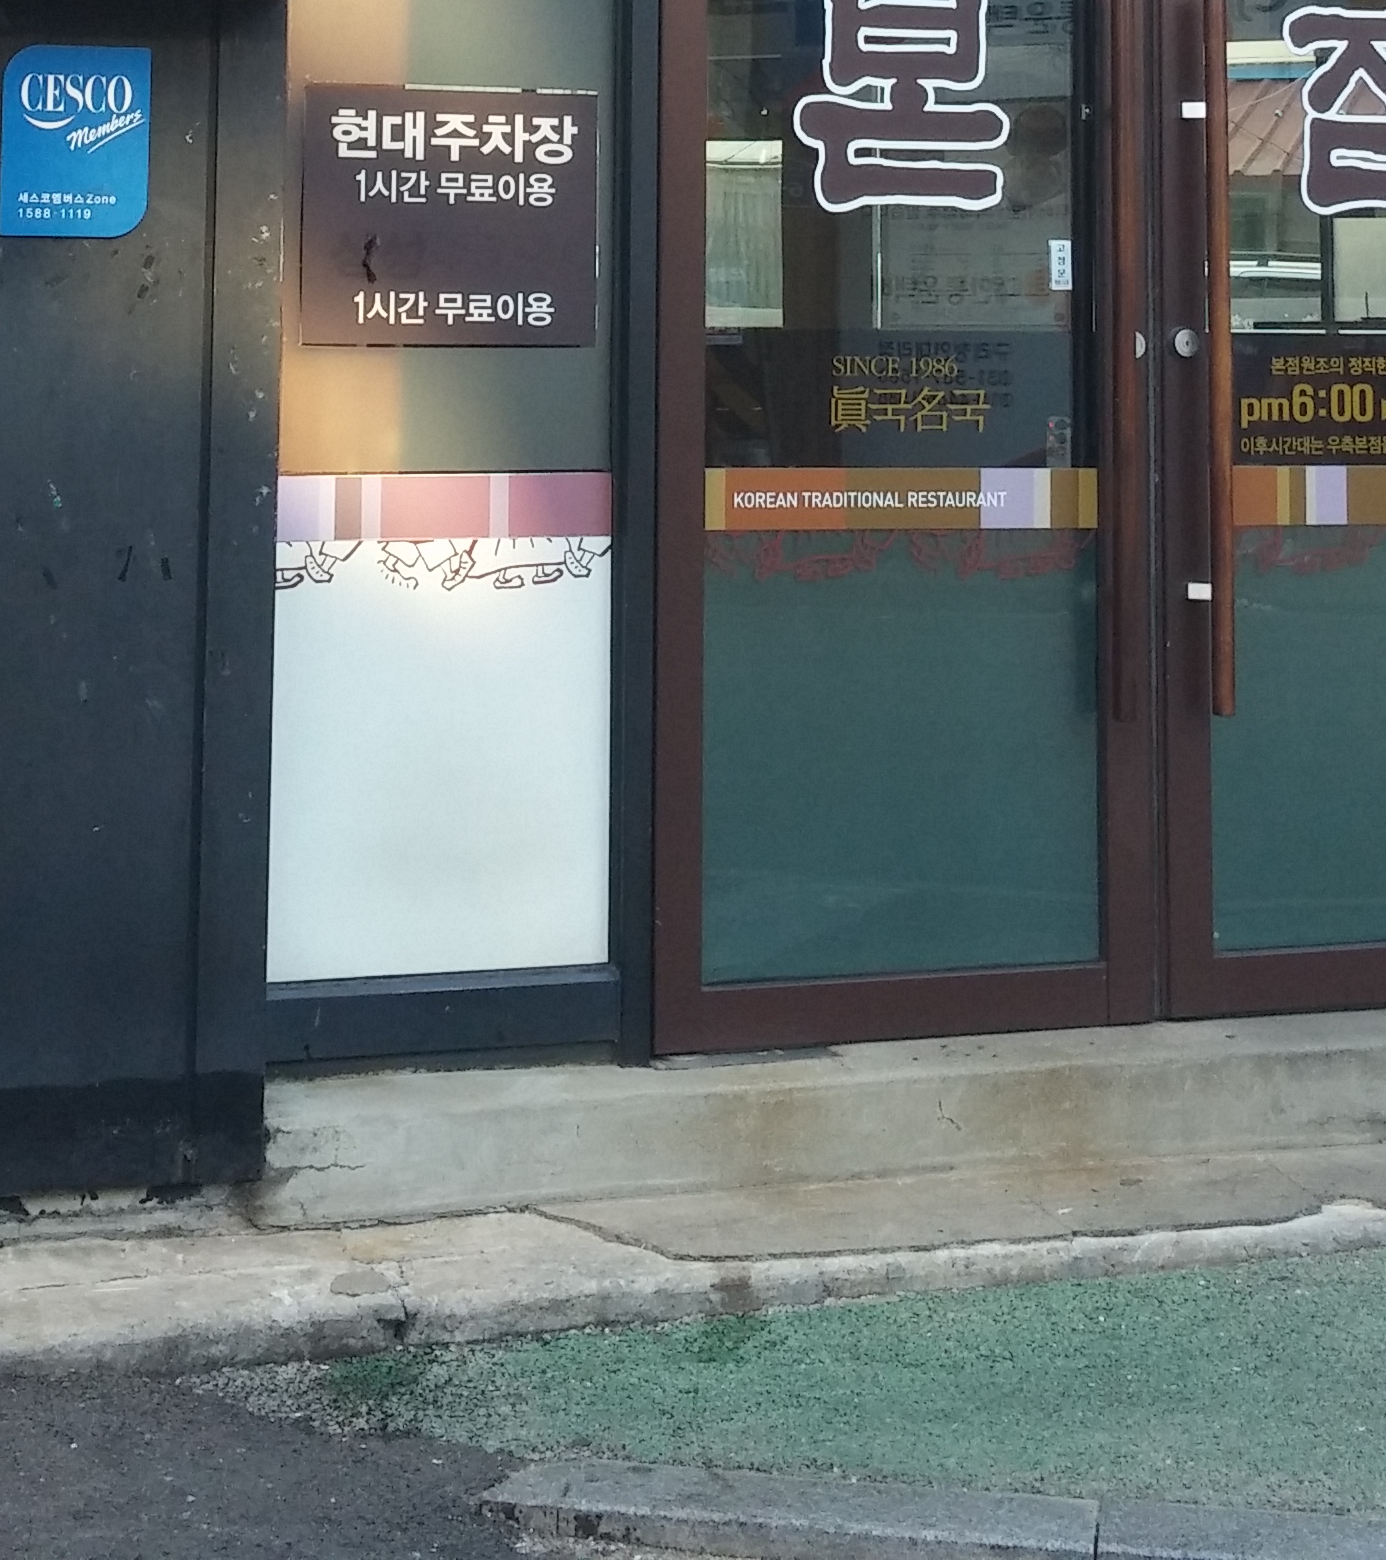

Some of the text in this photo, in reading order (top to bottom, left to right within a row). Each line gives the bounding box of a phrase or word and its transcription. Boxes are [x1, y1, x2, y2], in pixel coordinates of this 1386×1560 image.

[20, 72, 133, 114] CESCO
[65, 108, 142, 152] Members
[330, 108, 578, 165] 현대주차장
[355, 169, 556, 207] 1시간 무료이용
[17, 208, 92, 221] 1588-1119
[353, 290, 556, 327] 1시간 무료이용
[831, 355, 900, 378] SINCE
[909, 355, 958, 379] 1986
[733, 491, 1008, 509] KOREAN TRADITIONAL RESTAURANT
